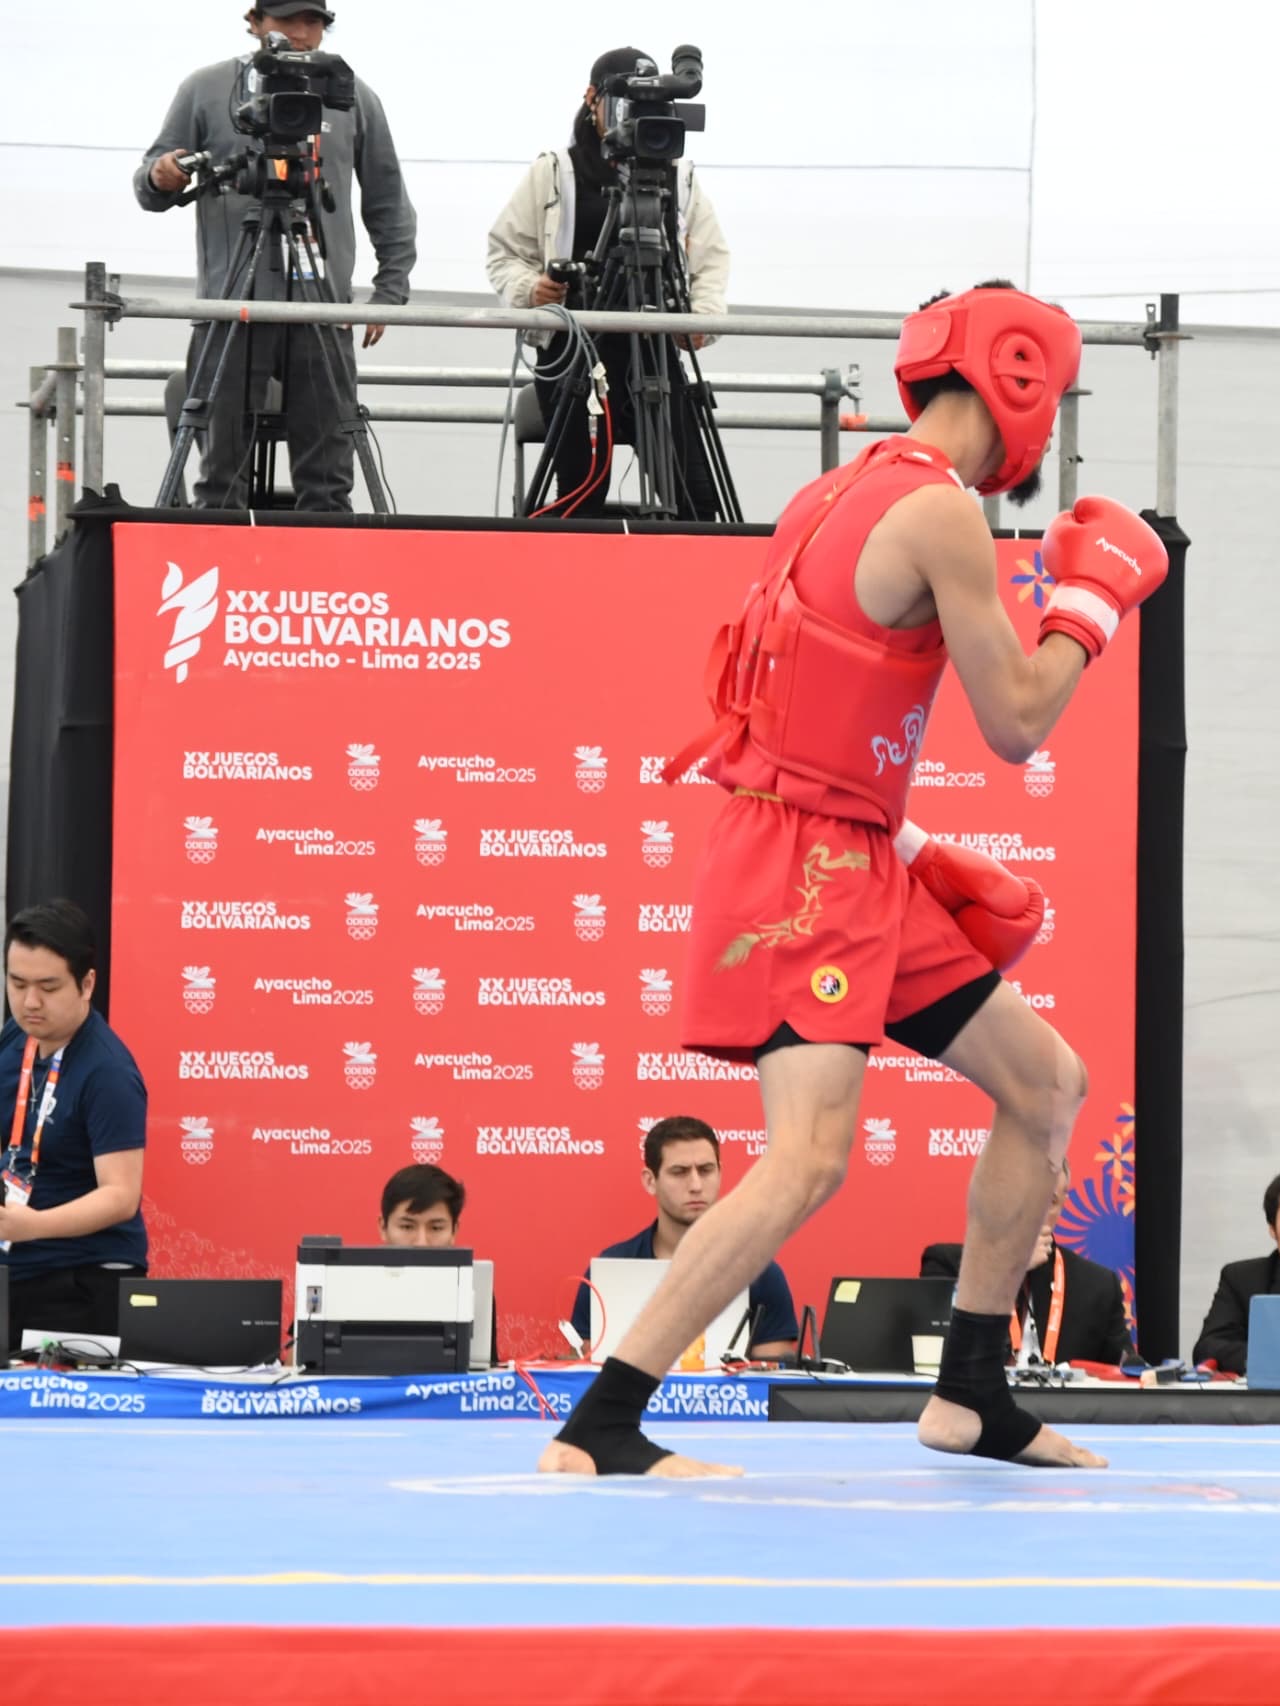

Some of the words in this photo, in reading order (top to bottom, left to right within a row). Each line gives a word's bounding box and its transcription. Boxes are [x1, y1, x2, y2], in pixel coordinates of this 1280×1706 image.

[1095, 536, 1142, 576] Ayacucho
[227, 590, 269, 613] XX
[273, 591, 389, 615] JUEGOS
[225, 615, 511, 648] BOLIVARIANOS
[224, 648, 340, 670] Ayacucho
[362, 649, 419, 669] Lima
[427, 651, 481, 670] 2025
[184, 752, 209, 766] XX
[212, 752, 278, 766] JUEGOS
[418, 755, 496, 770] Ayacucho
[183, 766, 312, 780] BOLIVARIANOS
[347, 767, 380, 777] ODEBO
[575, 769, 607, 779] ODEBO
[1023, 775, 1056, 784] ODEBO
[256, 828, 334, 844] Ayacucho
[480, 830, 506, 843] XX
[508, 830, 574, 844] JUEGOS
[960, 833, 1022, 847] JUEGOS
[185, 840, 218, 850] ODEBO
[414, 843, 447, 852] ODEBO
[480, 843, 607, 857] BOLIVARIANOS
[641, 844, 673, 854] ODEBO
[182, 902, 208, 916] XX
[210, 902, 277, 916] JUEGOS
[416, 904, 494, 919] Ayacucho
[181, 915, 311, 929] BOLIVARIANOS
[345, 917, 378, 927] ODEBO
[573, 918, 606, 928] ODEBO
[253, 977, 332, 993] Ayacucho
[478, 978, 504, 992] XX
[506, 978, 572, 992] JUEGOS
[183, 990, 215, 1000] ODEBO
[413, 991, 445, 1001] ODEBO
[478, 992, 606, 1006] BOLIVARIANOS
[640, 992, 672, 1002] ODEBO
[180, 1052, 206, 1065] XX
[208, 1052, 274, 1066] JUEGOS
[414, 1053, 492, 1068] Ayacucho
[179, 1065, 309, 1079] BOLIVARIANOS
[344, 1066, 376, 1076] ODEBO
[572, 1066, 604, 1076] ODEBO
[252, 1127, 331, 1143] Ayacucho
[477, 1127, 502, 1141] XX
[505, 1127, 570, 1141] JUEGOS
[181, 1141, 214, 1150] ODEBO
[411, 1141, 444, 1151] ODEBO
[476, 1141, 605, 1155] BOLIVARIANOS
[864, 1143, 896, 1152] ODEBO
[405, 1375, 516, 1400] Ayacucho
[666, 1383, 748, 1400] JUEGOS
[201, 1396, 362, 1414] BOLIVARIANOS
